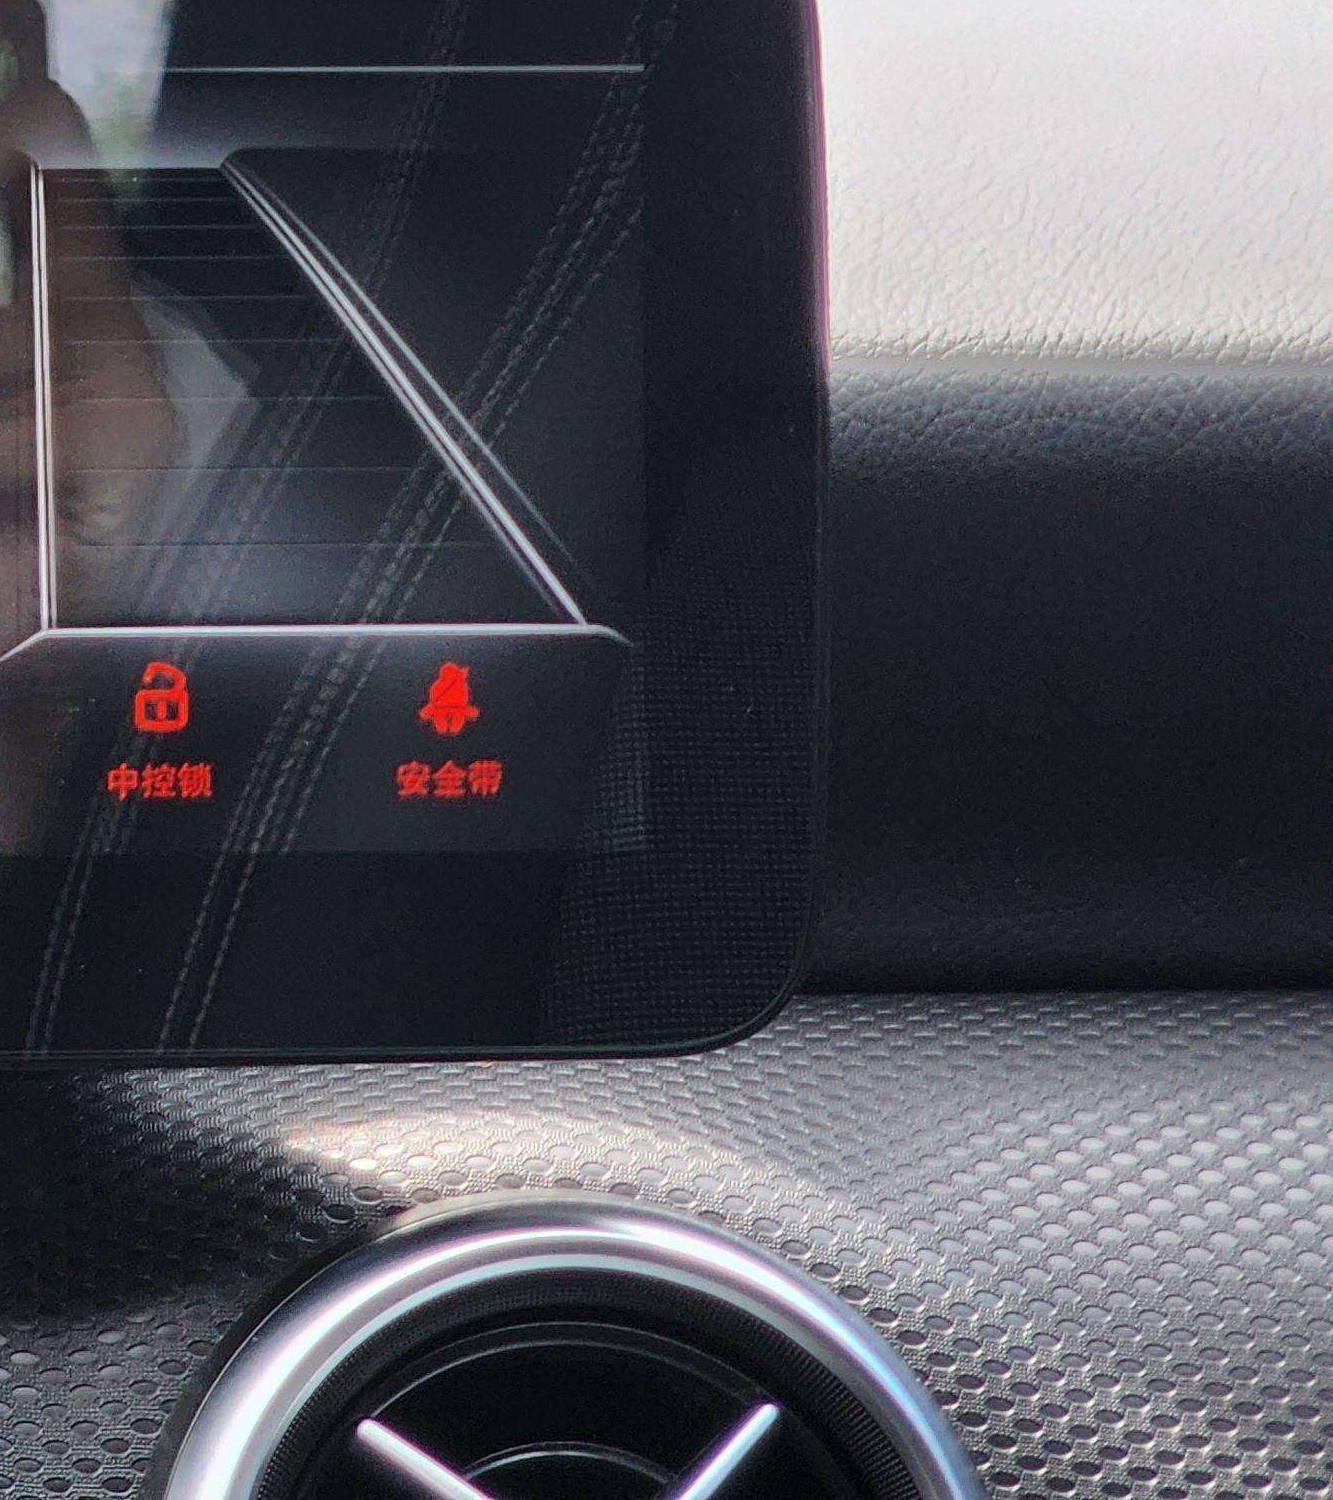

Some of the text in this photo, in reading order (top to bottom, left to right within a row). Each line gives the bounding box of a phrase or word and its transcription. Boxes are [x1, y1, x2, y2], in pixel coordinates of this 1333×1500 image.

[106, 762, 214, 800] 中控锁
[396, 759, 504, 797] 安全带
